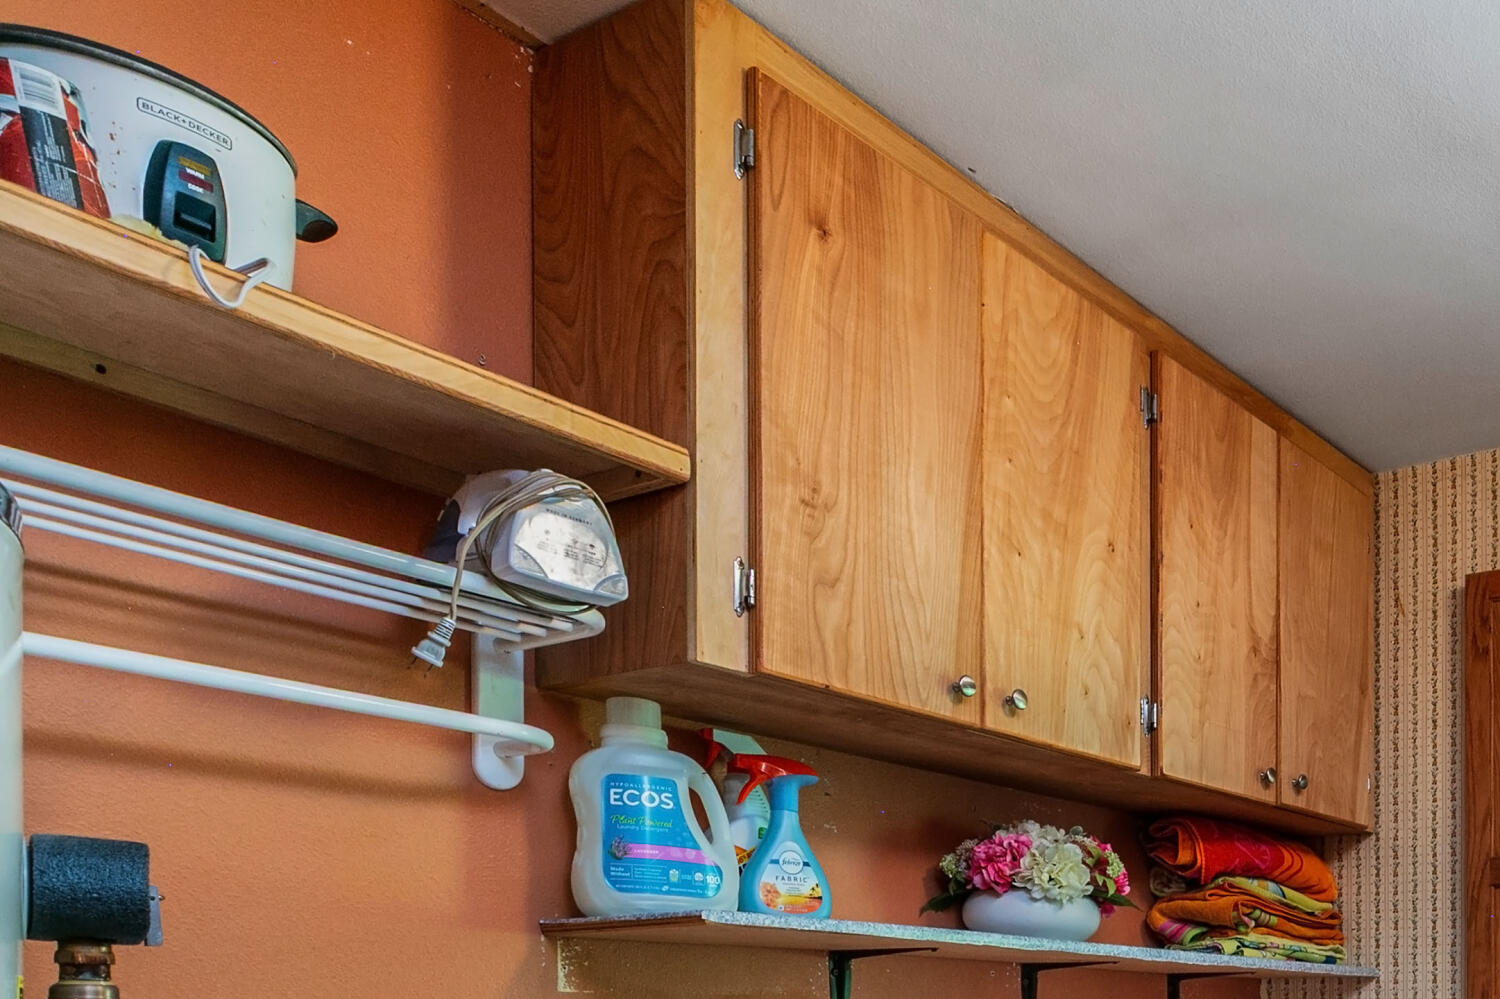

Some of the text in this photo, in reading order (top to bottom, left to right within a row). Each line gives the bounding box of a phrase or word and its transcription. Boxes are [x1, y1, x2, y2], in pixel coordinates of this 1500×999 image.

[142, 101, 229, 146] BLACK+DECKER
[609, 788, 674, 809] ECOS
[610, 814, 636, 825] Plant
[705, 874, 720, 885] 100
[775, 874, 808, 883] FABRIC
